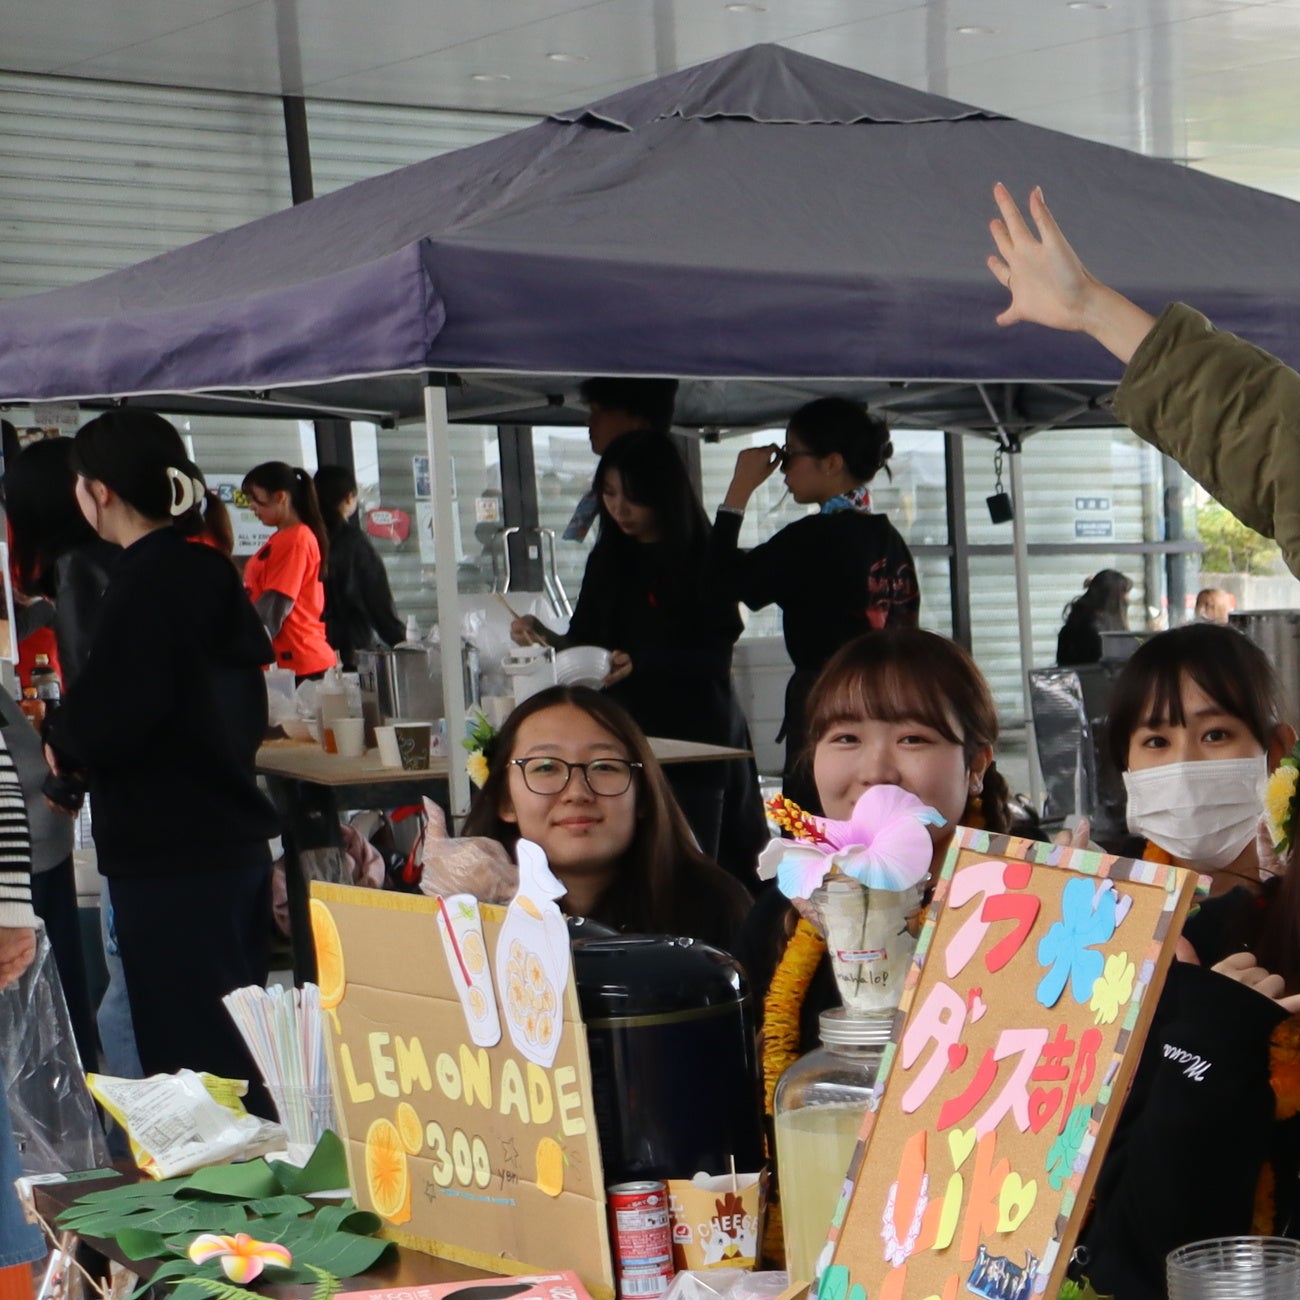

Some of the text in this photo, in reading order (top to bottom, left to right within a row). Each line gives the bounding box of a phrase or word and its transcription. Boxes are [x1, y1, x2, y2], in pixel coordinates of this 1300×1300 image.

[949, 861, 1040, 979] フラ
[340, 1030, 586, 1137] LEMONADE
[902, 981, 1103, 1140] ダンス部
[425, 1119, 491, 1190] 300
